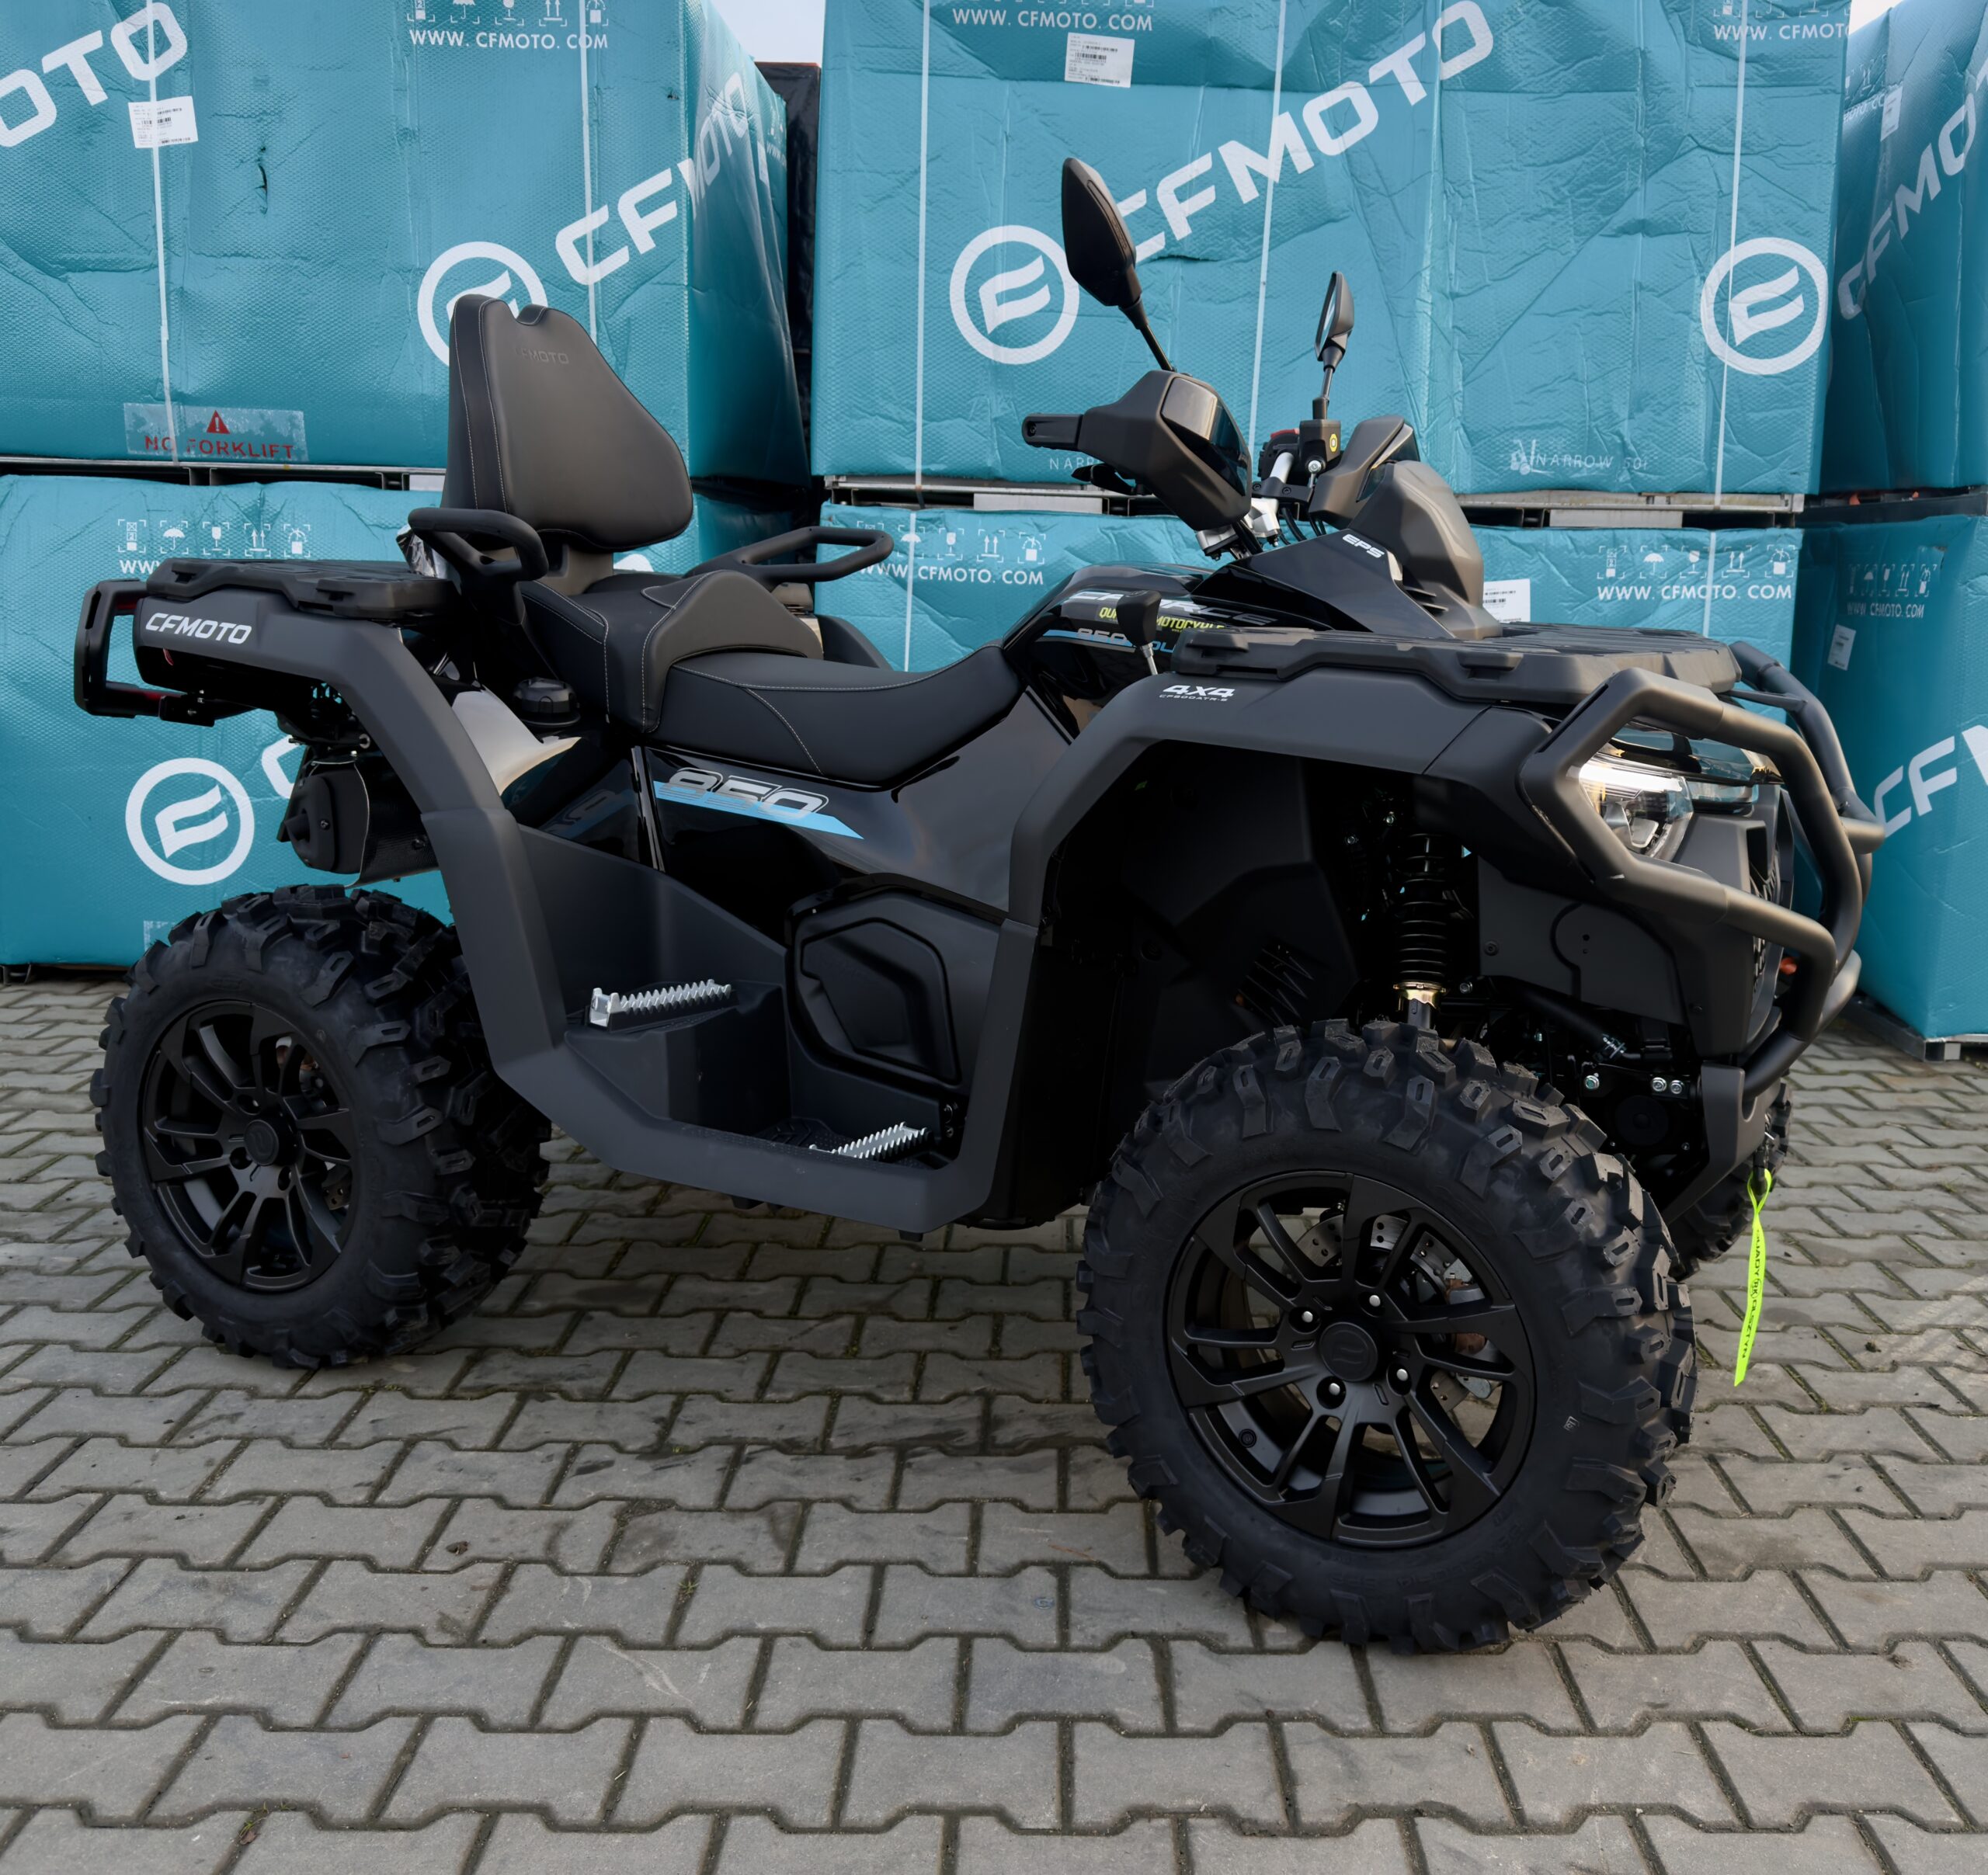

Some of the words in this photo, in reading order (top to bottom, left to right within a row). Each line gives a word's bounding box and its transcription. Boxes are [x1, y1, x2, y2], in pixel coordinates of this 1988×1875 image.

[1778, 23, 1849, 40] CFMOT
[1838, 57, 1988, 320] CFMO
[144, 436, 174, 451] NO
[186, 438, 294, 459] FORKLIFT
[1535, 453, 1614, 469] NARROW
[1343, 534, 1385, 558] EPS
[120, 560, 161, 575] WW
[1062, 591, 1279, 627] CFRCE
[146, 613, 252, 644] CFMOTO
[659, 767, 829, 821] 850
[1741, 1300, 1757, 1359] OLSZTYN
